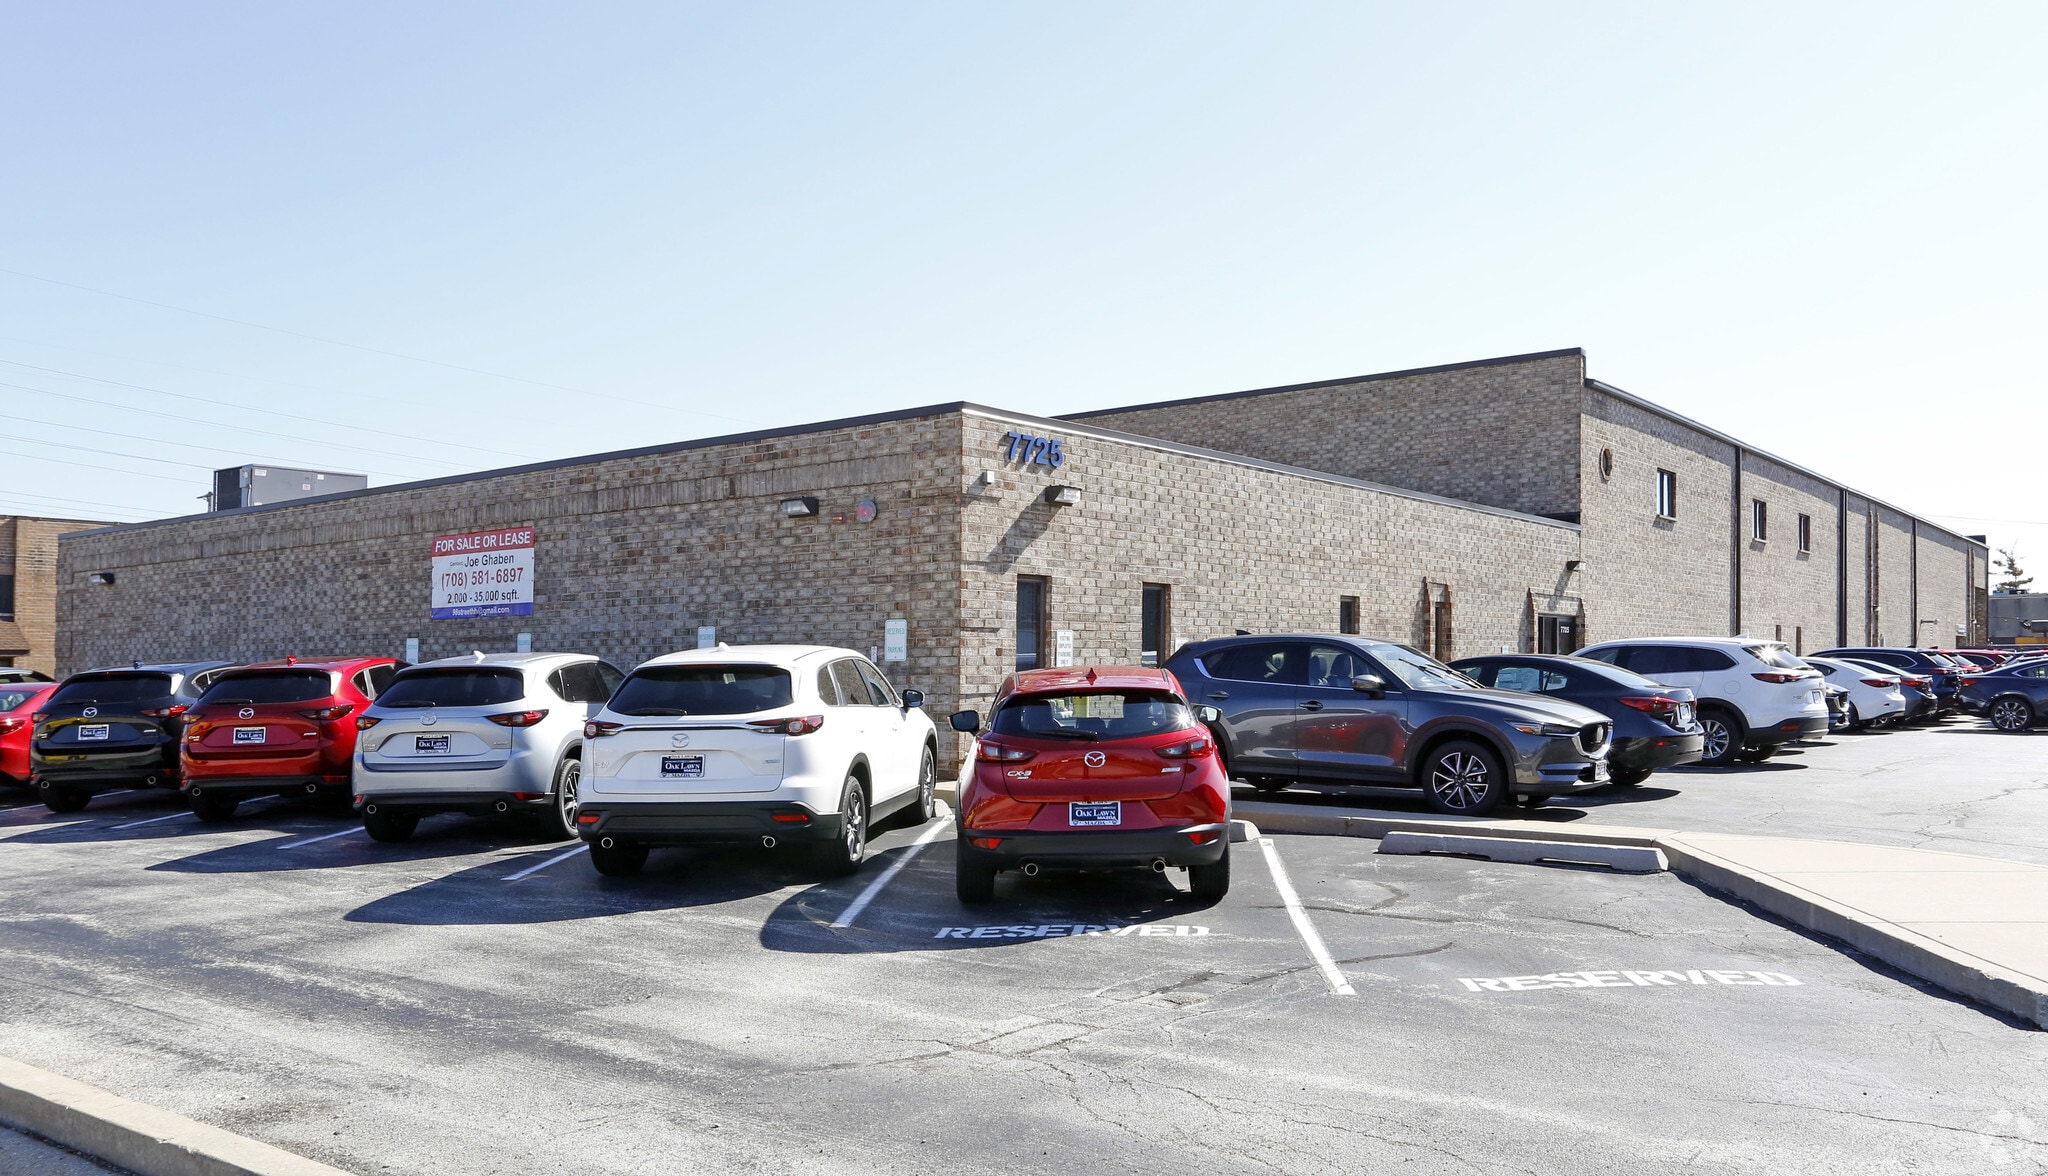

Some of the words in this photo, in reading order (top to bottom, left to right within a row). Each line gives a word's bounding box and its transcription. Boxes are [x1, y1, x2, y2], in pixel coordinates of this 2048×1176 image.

[1007, 431, 1064, 467] 7725
[435, 540, 454, 552] FOR
[456, 536, 481, 550] SALE
[482, 534, 497, 548] OR
[499, 531, 531, 546] LEASE
[464, 556, 480, 567] Joe
[481, 553, 515, 566] Ghaben
[441, 571, 468, 591] (708)
[471, 567, 524, 586] 581-6897
[447, 592, 468, 605] 2,000
[473, 590, 500, 603] 35,000
[501, 589, 520, 602] sqft.
[665, 762, 680, 770] OAK
[681, 762, 701, 770] LAWN
[1075, 809, 1092, 817] OAK
[1093, 809, 1116, 817] LAWN
[934, 924, 1210, 939] RESERVED
[1457, 969, 1805, 992] RESERVED
